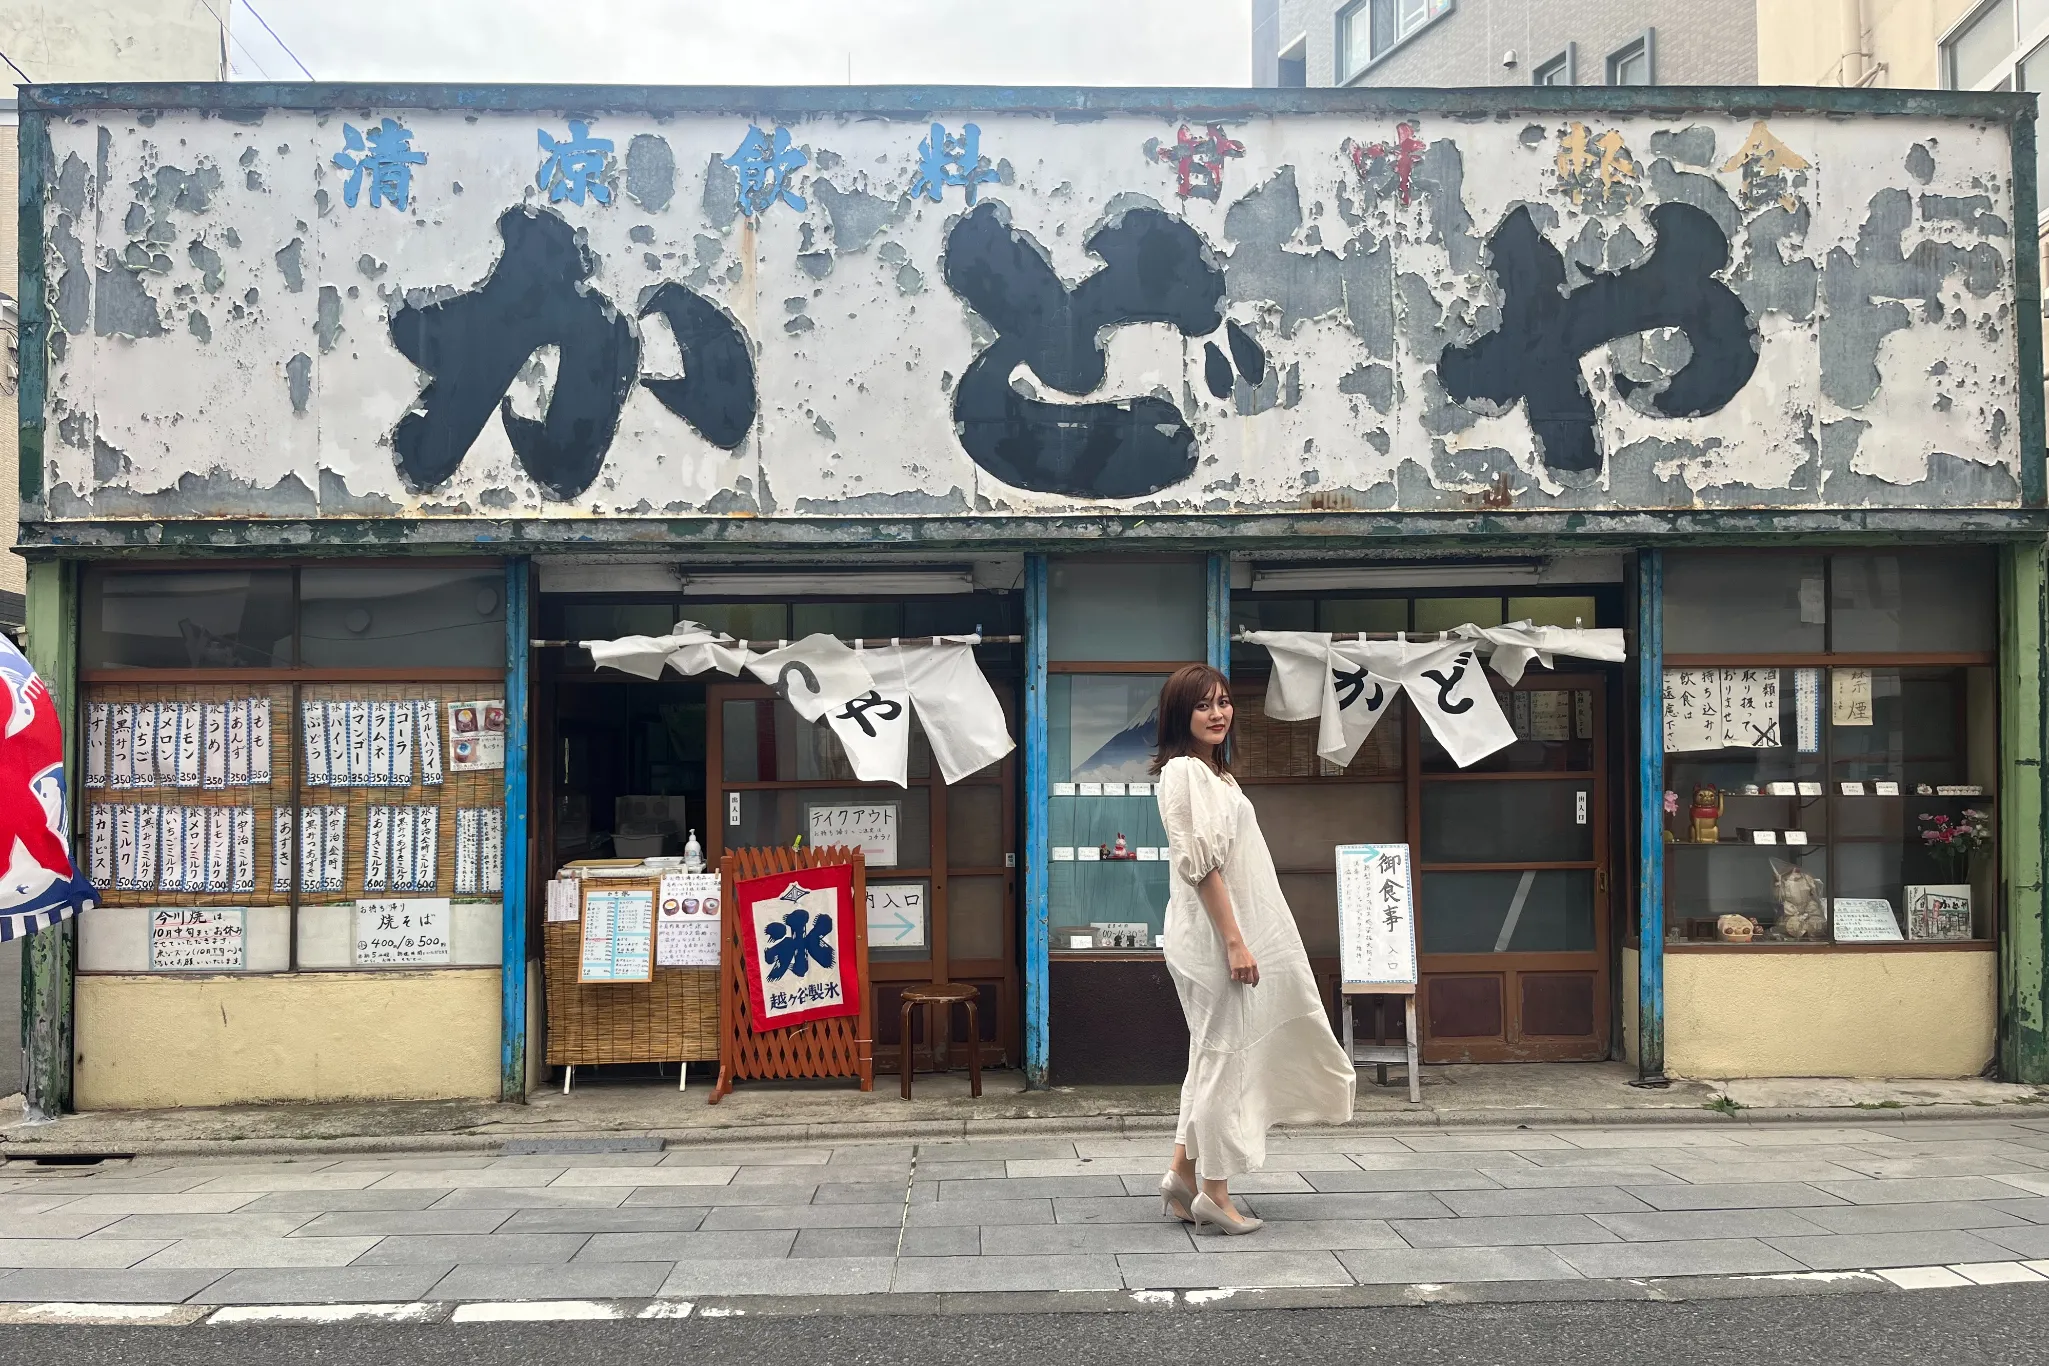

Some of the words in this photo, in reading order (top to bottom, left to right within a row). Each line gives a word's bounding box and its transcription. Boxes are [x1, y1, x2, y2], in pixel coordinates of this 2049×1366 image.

[334, 117, 1000, 214] 清涼飲料
[391, 200, 1760, 501] かどや
[1680, 672, 1696, 719] 飲食は
[1847, 670, 1870, 720] 禁煙
[1702, 670, 1717, 742] 持ち込みの
[87, 774, 105, 783] 350
[113, 774, 131, 784] 350
[135, 774, 153, 783] 350
[161, 774, 176, 782] 350
[179, 772, 197, 781] 350
[230, 773, 247, 782] 350
[252, 770, 268, 779] 350
[310, 773, 327, 782] 350
[332, 774, 348, 783] 350
[352, 774, 369, 782] 350
[371, 773, 388, 782] 350
[393, 774, 410, 783] 350
[425, 773, 441, 781] 350
[206, 776, 222, 785] 350
[812, 809, 893, 827] テイクアウト
[92, 877, 110, 886] 500
[136, 880, 154, 888] 500
[162, 879, 181, 887] 500
[184, 881, 204, 890] 500
[209, 880, 226, 889] 500
[235, 879, 253, 889] 500
[303, 880, 320, 889] 550
[322, 878, 341, 887] 550
[367, 879, 384, 888] 600
[393, 881, 412, 889] 600
[417, 880, 435, 889] 600
[1377, 852, 1405, 933] 御食事
[360, 902, 405, 913] お持ち帰り
[377, 914, 436, 930] 焼そば
[764, 909, 836, 983] 氷
[1387, 945, 1399, 970] 入口
